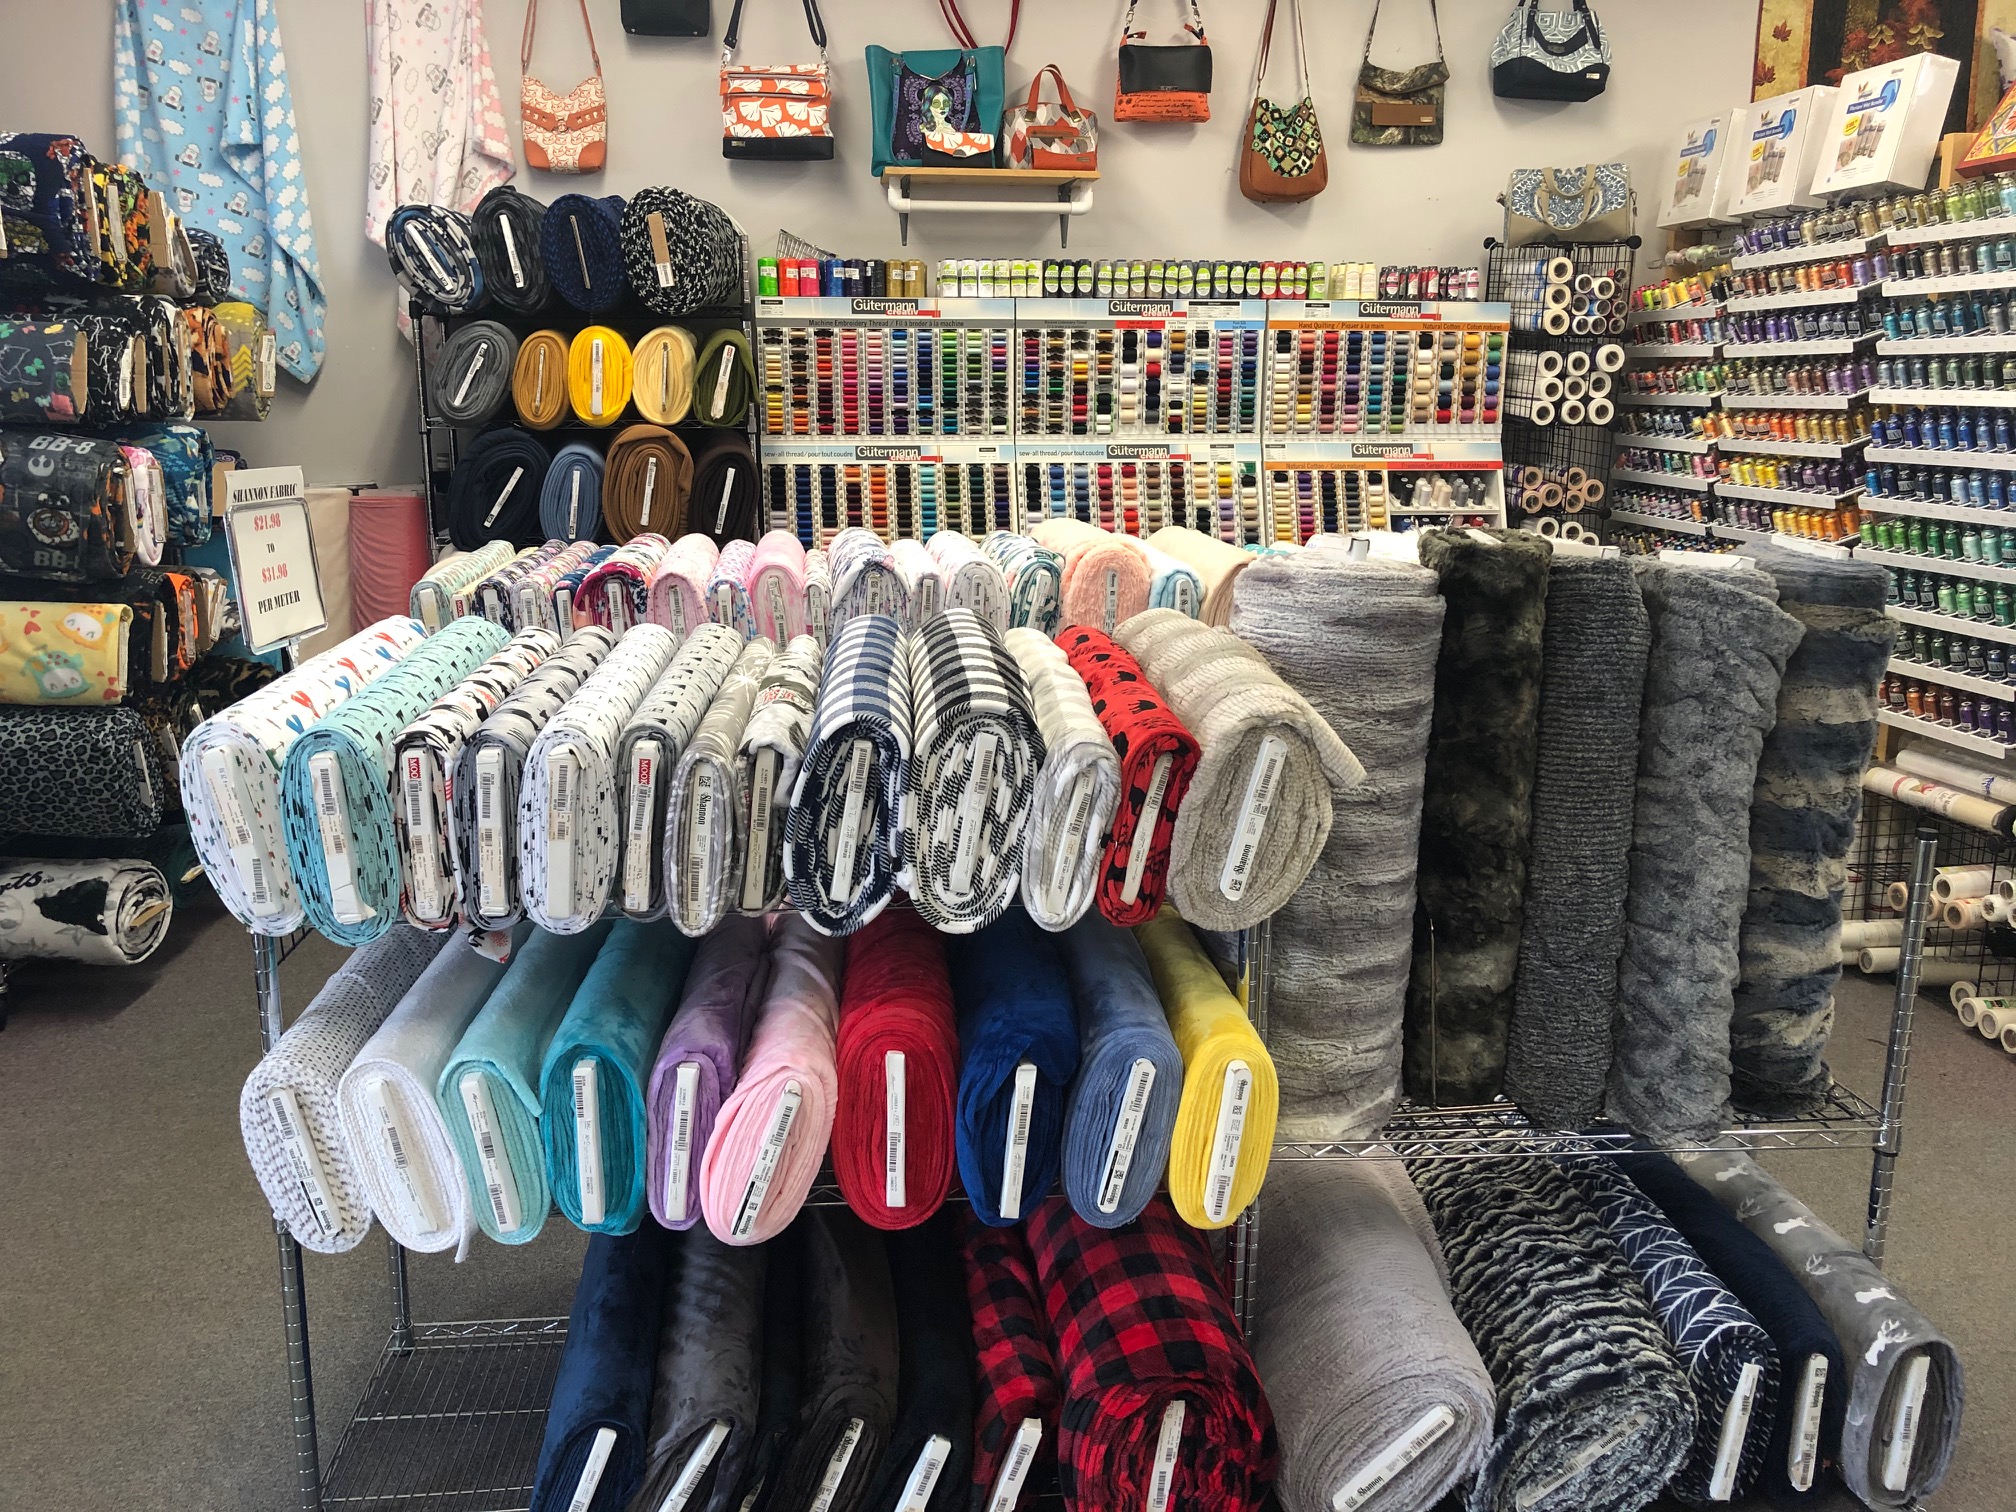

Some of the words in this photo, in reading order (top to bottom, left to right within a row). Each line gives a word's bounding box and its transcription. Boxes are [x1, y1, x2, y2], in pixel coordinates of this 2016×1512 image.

[853, 300, 915, 311] Gütermann
[1110, 301, 1170, 312] Gütermann
[1360, 303, 1418, 314] Gütermann
[835, 320, 867, 328] Embroidery
[1342, 322, 1359, 331] Piquer
[28, 436, 96, 454] BB-8
[857, 447, 918, 458] Gütermann
[1108, 446, 1168, 456] Gütermann
[1353, 444, 1410, 456] Gütermann
[232, 486, 268, 503] SHANNON
[270, 483, 298, 499] FABRIC
[254, 512, 281, 532] $21.98
[266, 543, 274, 554] TO
[262, 563, 288, 584] $31.98
[258, 598, 274, 614] PER
[274, 590, 300, 610] METER
[409, 758, 418, 778] MOO
[639, 759, 648, 784] MOOK
[697, 792, 711, 825] Shannon
[1232, 842, 1252, 875] Shannon
[835, 1434, 855, 1464] Shannon
[1599, 1429, 1627, 1451] Shannon
[1356, 1471, 1383, 1498] Shannon
